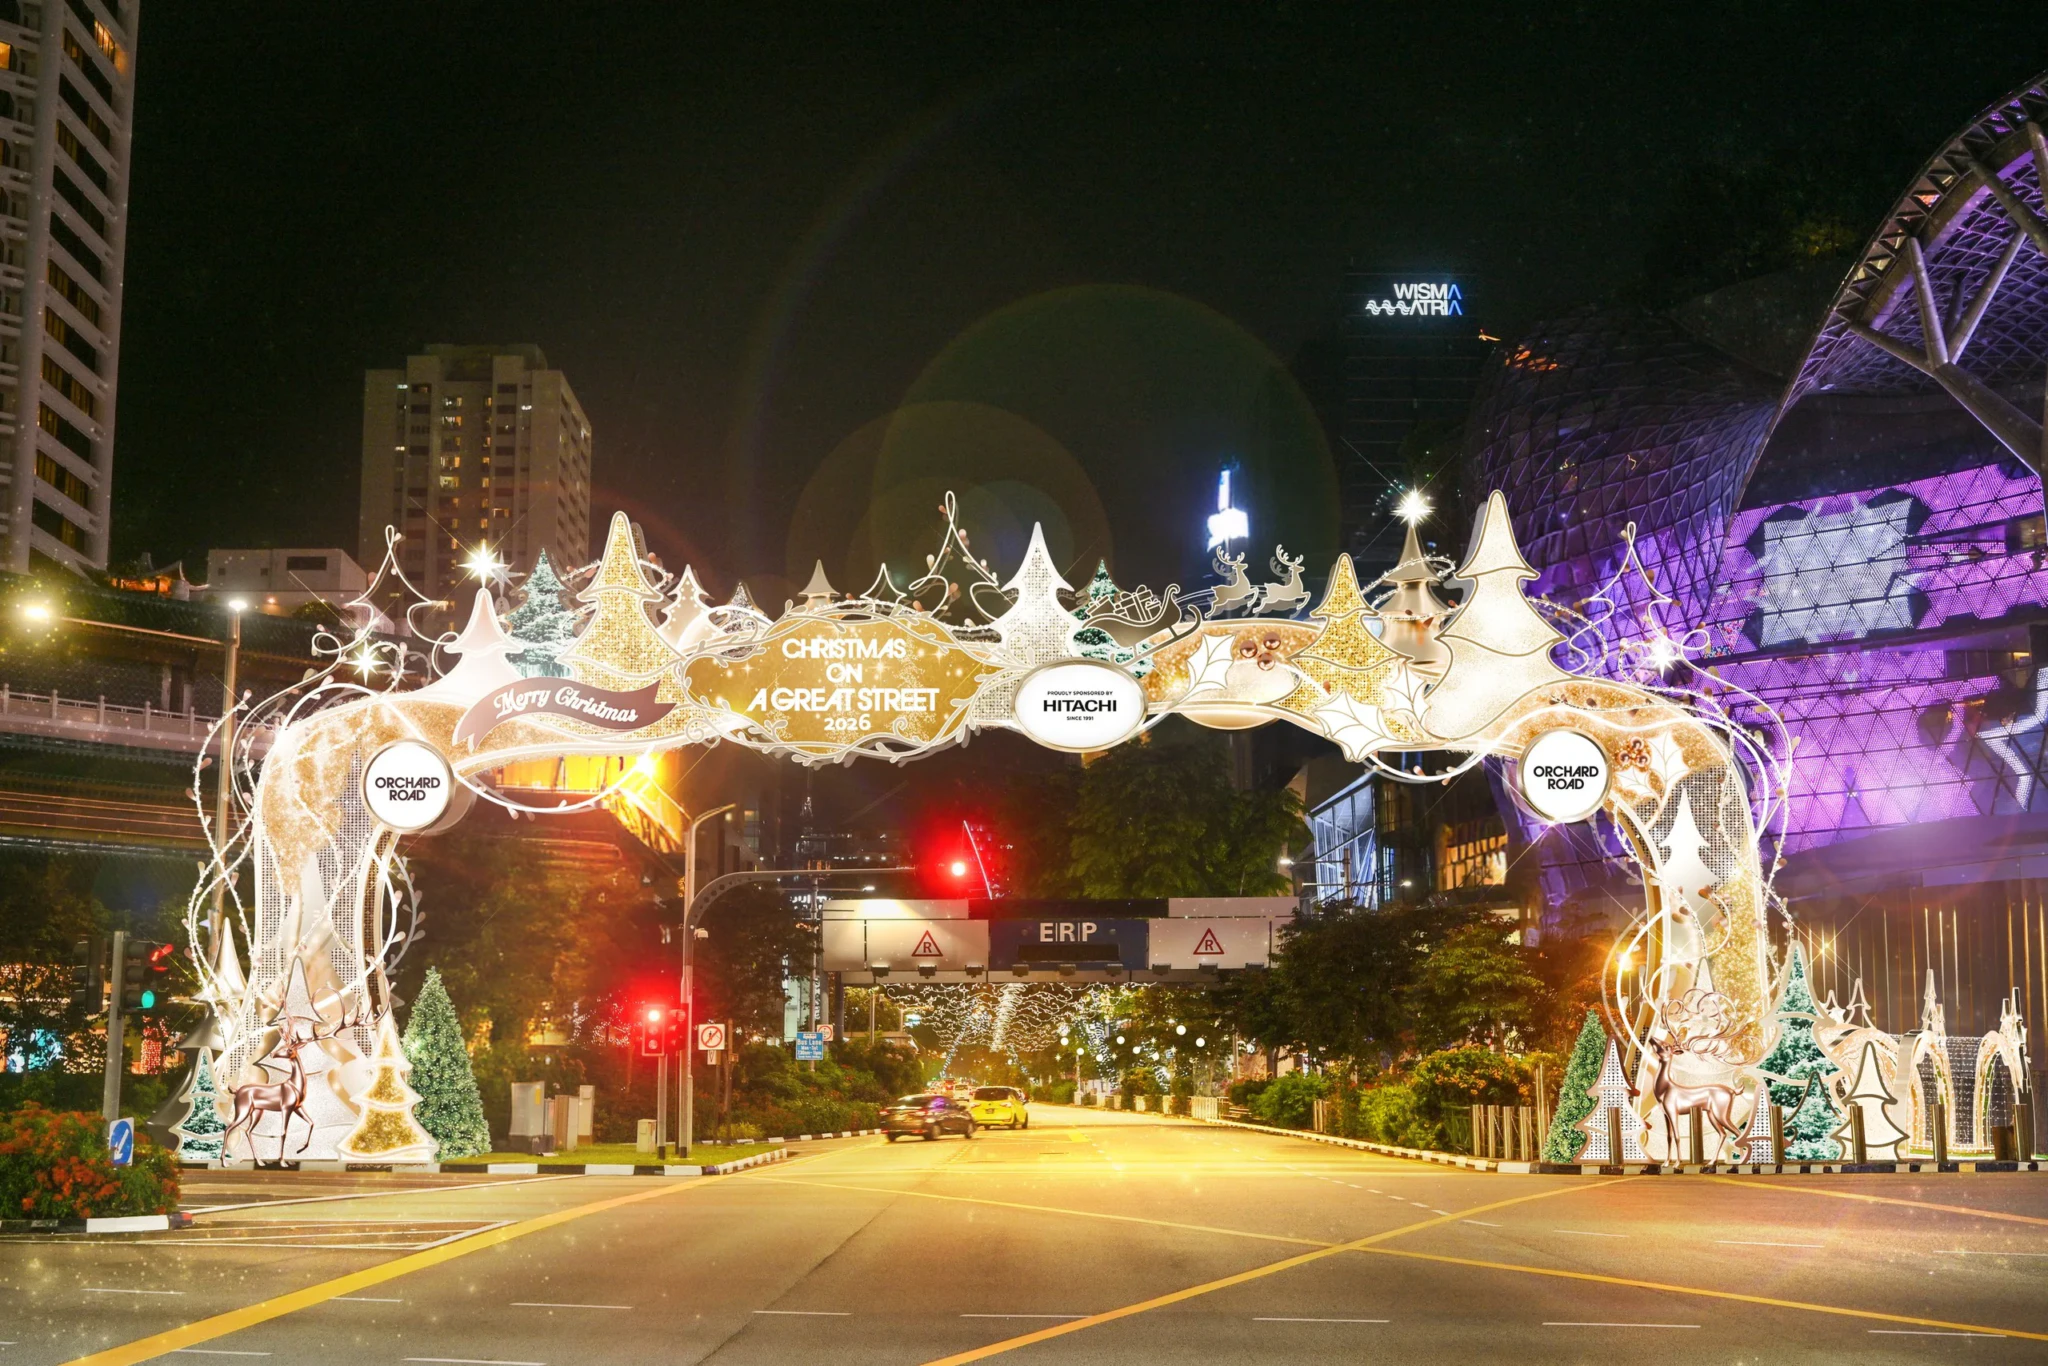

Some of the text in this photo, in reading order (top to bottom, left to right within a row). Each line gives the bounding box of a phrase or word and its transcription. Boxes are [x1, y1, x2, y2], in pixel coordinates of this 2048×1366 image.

[1393, 283, 1462, 300] WISMA
[1409, 300, 1463, 316] ATRIA
[782, 638, 907, 659] CHRISTMAS
[826, 662, 863, 683] ON
[493, 686, 638, 722] Merry Christmas
[747, 688, 940, 711] A GREAT STREET
[1043, 700, 1117, 712] HITACHI
[824, 713, 871, 731] 2026
[1533, 766, 1599, 777] ORCHARD
[375, 777, 440, 788] ORCHARD
[1548, 778, 1584, 790] ROAD
[389, 790, 426, 801] ROAD
[923, 941, 932, 953] R
[1205, 939, 1214, 951] R
